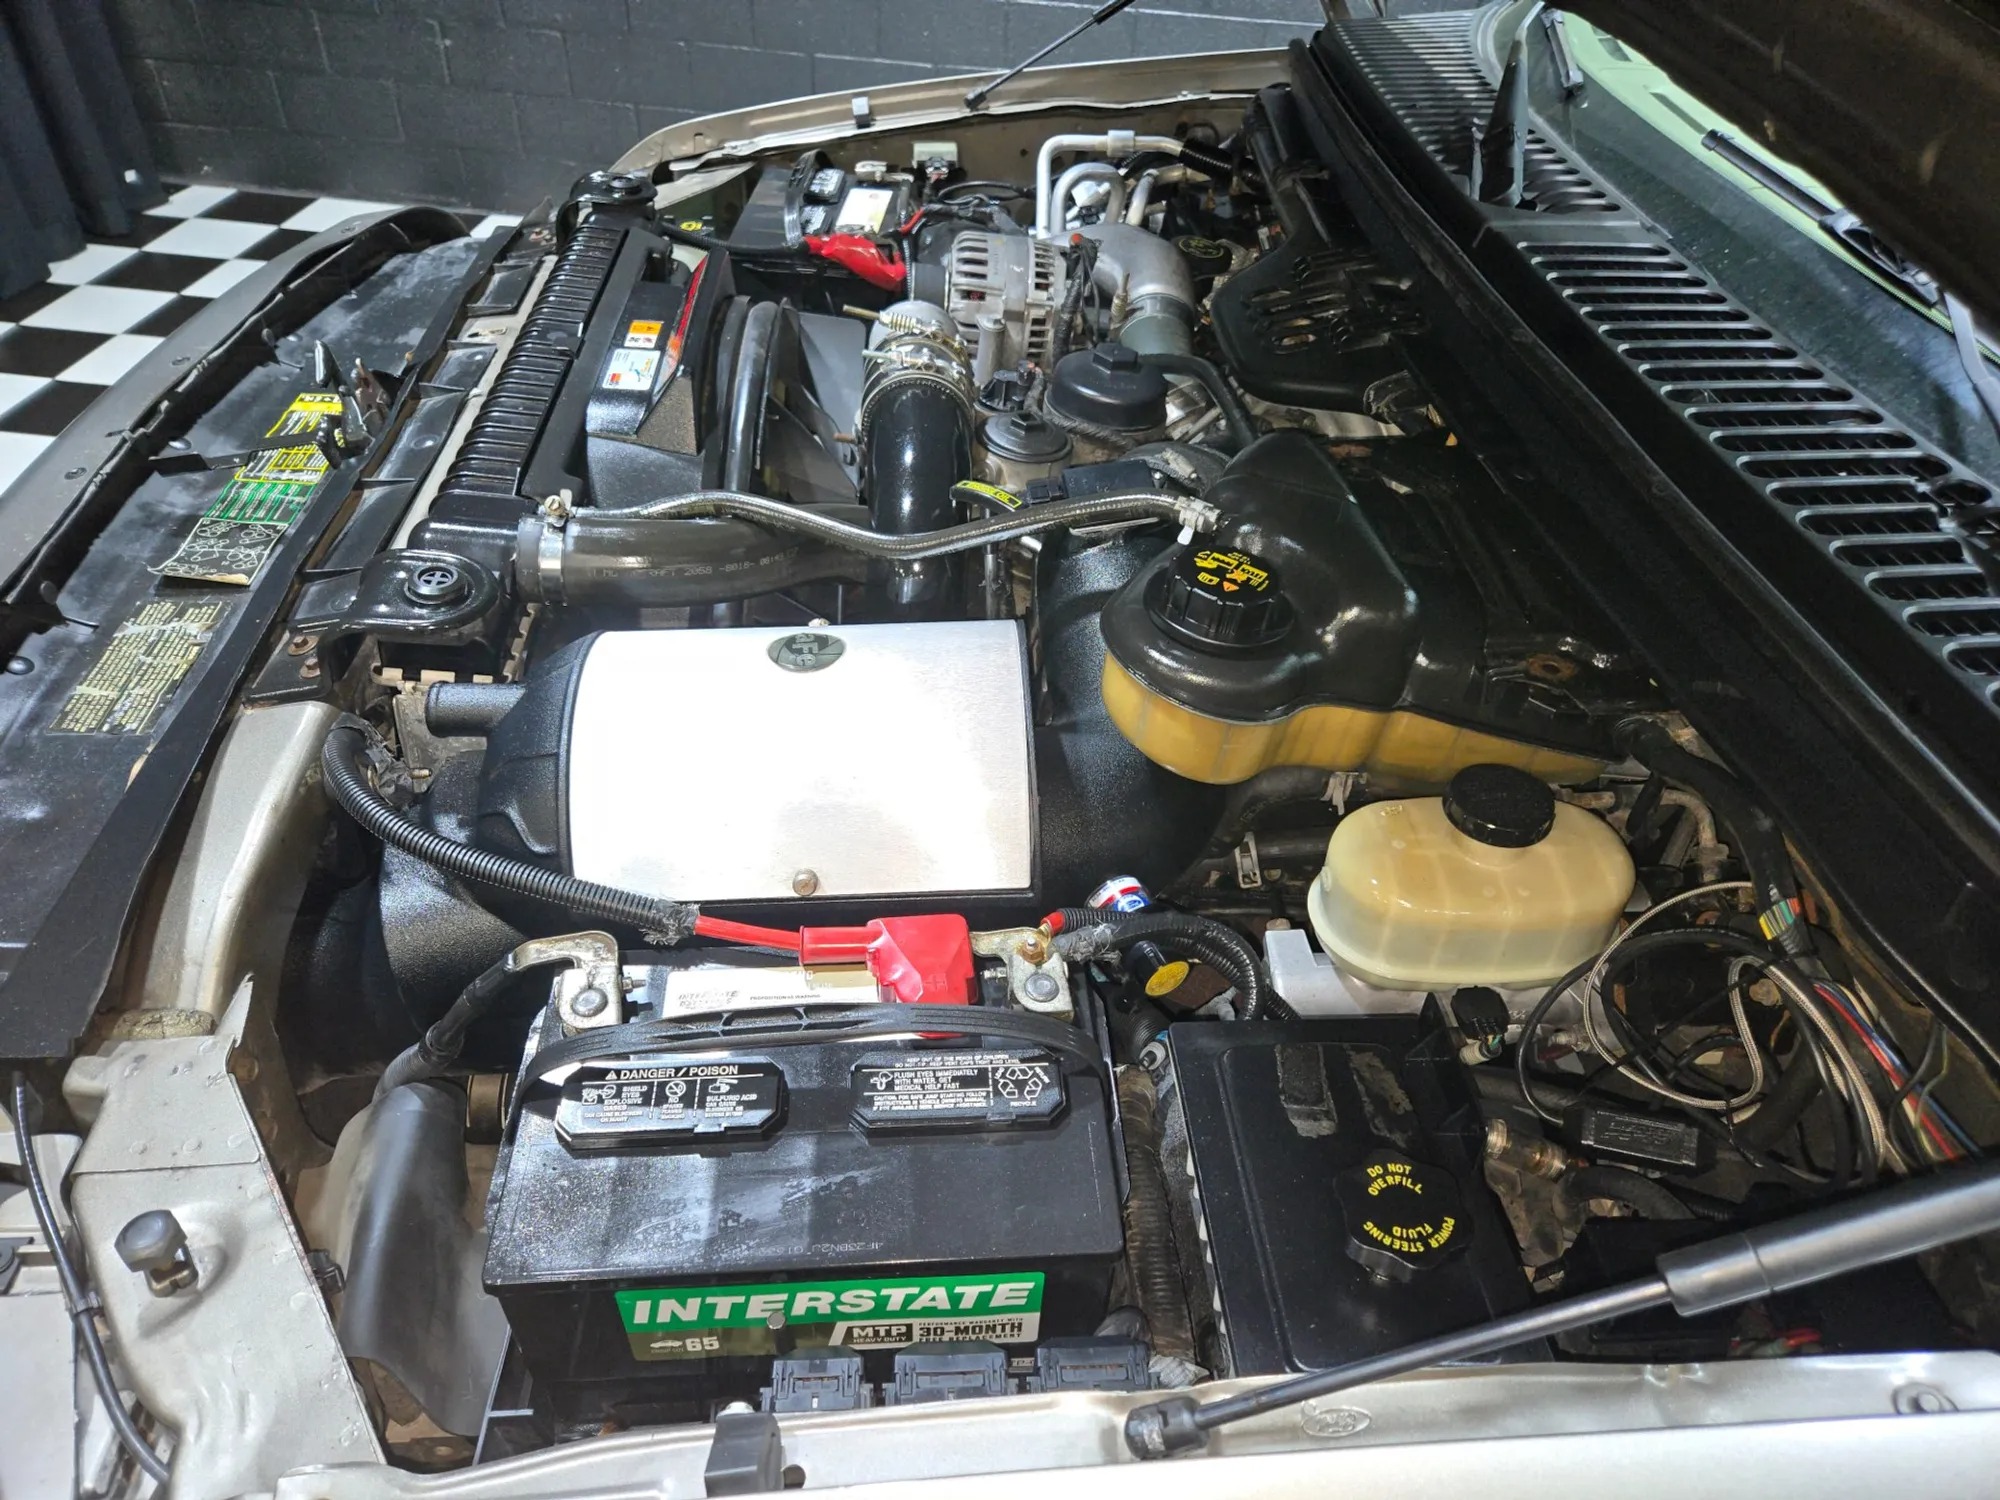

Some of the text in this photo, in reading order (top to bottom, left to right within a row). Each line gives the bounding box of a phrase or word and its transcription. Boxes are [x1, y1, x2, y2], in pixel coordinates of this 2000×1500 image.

[620, 1068, 675, 1079] DANGER
[689, 1065, 739, 1076] POISON
[894, 1069, 978, 1079] FLUSH EYES IMMEDIATELY
[604, 1097, 643, 1105] EXPLOSIVE
[1366, 1162, 1412, 1177] DO NOT
[1367, 1175, 1423, 1196] OVERFILL
[1363, 1216, 1456, 1253] POWER STEERING
[1392, 1222, 1434, 1239] FLUID
[633, 1281, 1035, 1324] INTERSTATE
[852, 1325, 907, 1338] MTP
[919, 1321, 1023, 1337] 30-MONTH
[685, 1336, 720, 1352] 65
